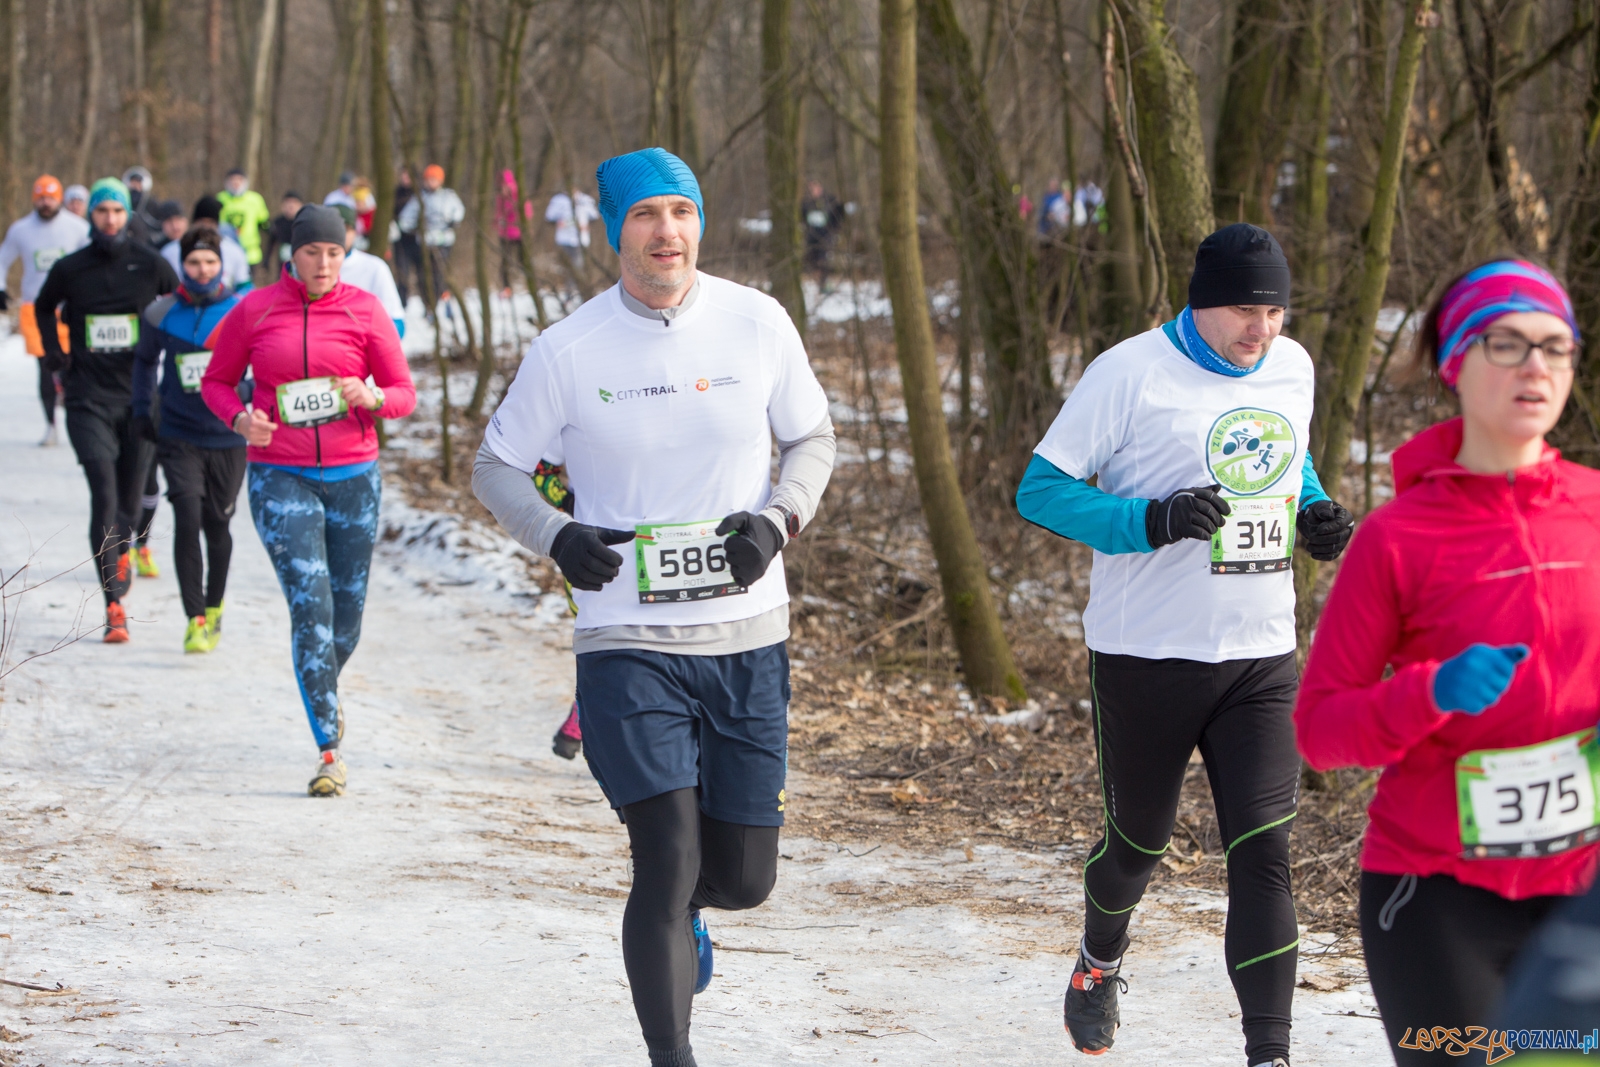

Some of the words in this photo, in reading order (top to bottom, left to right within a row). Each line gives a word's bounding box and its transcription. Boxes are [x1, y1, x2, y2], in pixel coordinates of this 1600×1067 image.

[293, 392, 334, 413] 489
[1212, 413, 1255, 448] ZIELONKA
[1219, 473, 1246, 490] CROSS
[1250, 456, 1290, 490] DUATHLON
[1237, 519, 1282, 550] 314
[660, 544, 726, 578] 586
[683, 578, 706, 587] PIOTR
[1495, 773, 1580, 825] 375
